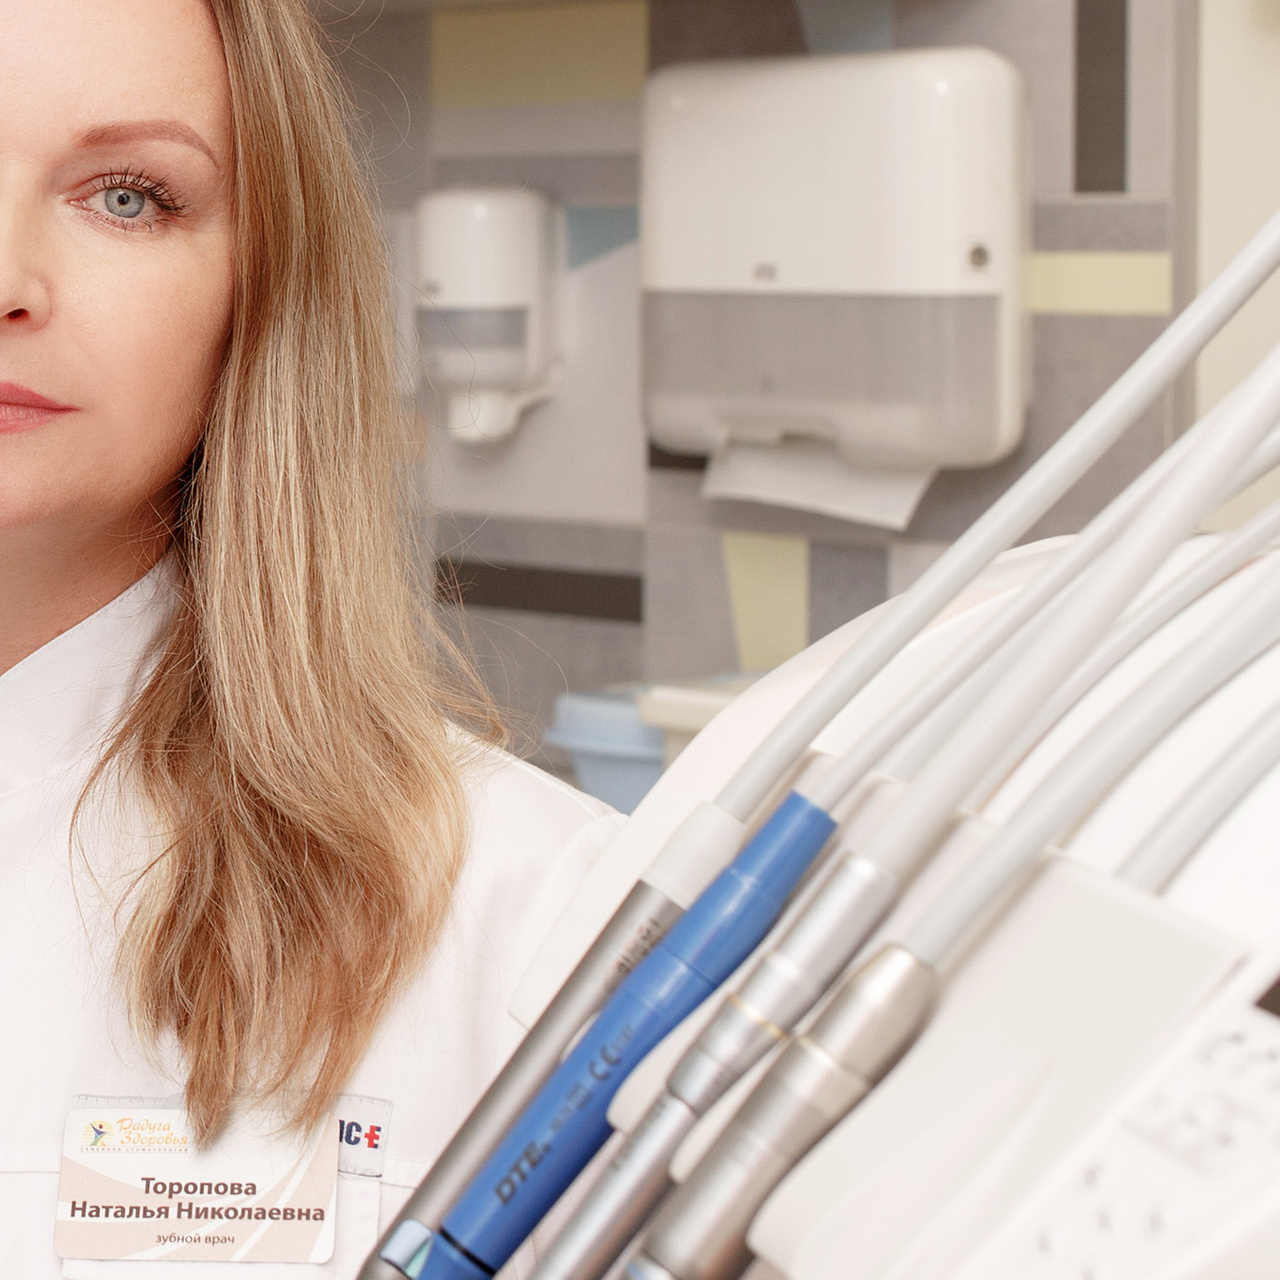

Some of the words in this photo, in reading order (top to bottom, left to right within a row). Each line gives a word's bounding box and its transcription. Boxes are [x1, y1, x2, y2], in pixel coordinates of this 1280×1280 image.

[116, 1117, 171, 1133] Радуга
[120, 1130, 189, 1147] Здоровья
[141, 1177, 257, 1198] Торопова
[70, 1200, 170, 1219] Наталья
[176, 1202, 326, 1221] Николаевна
[155, 1233, 201, 1245] зубной
[204, 1234, 235, 1245] врач
